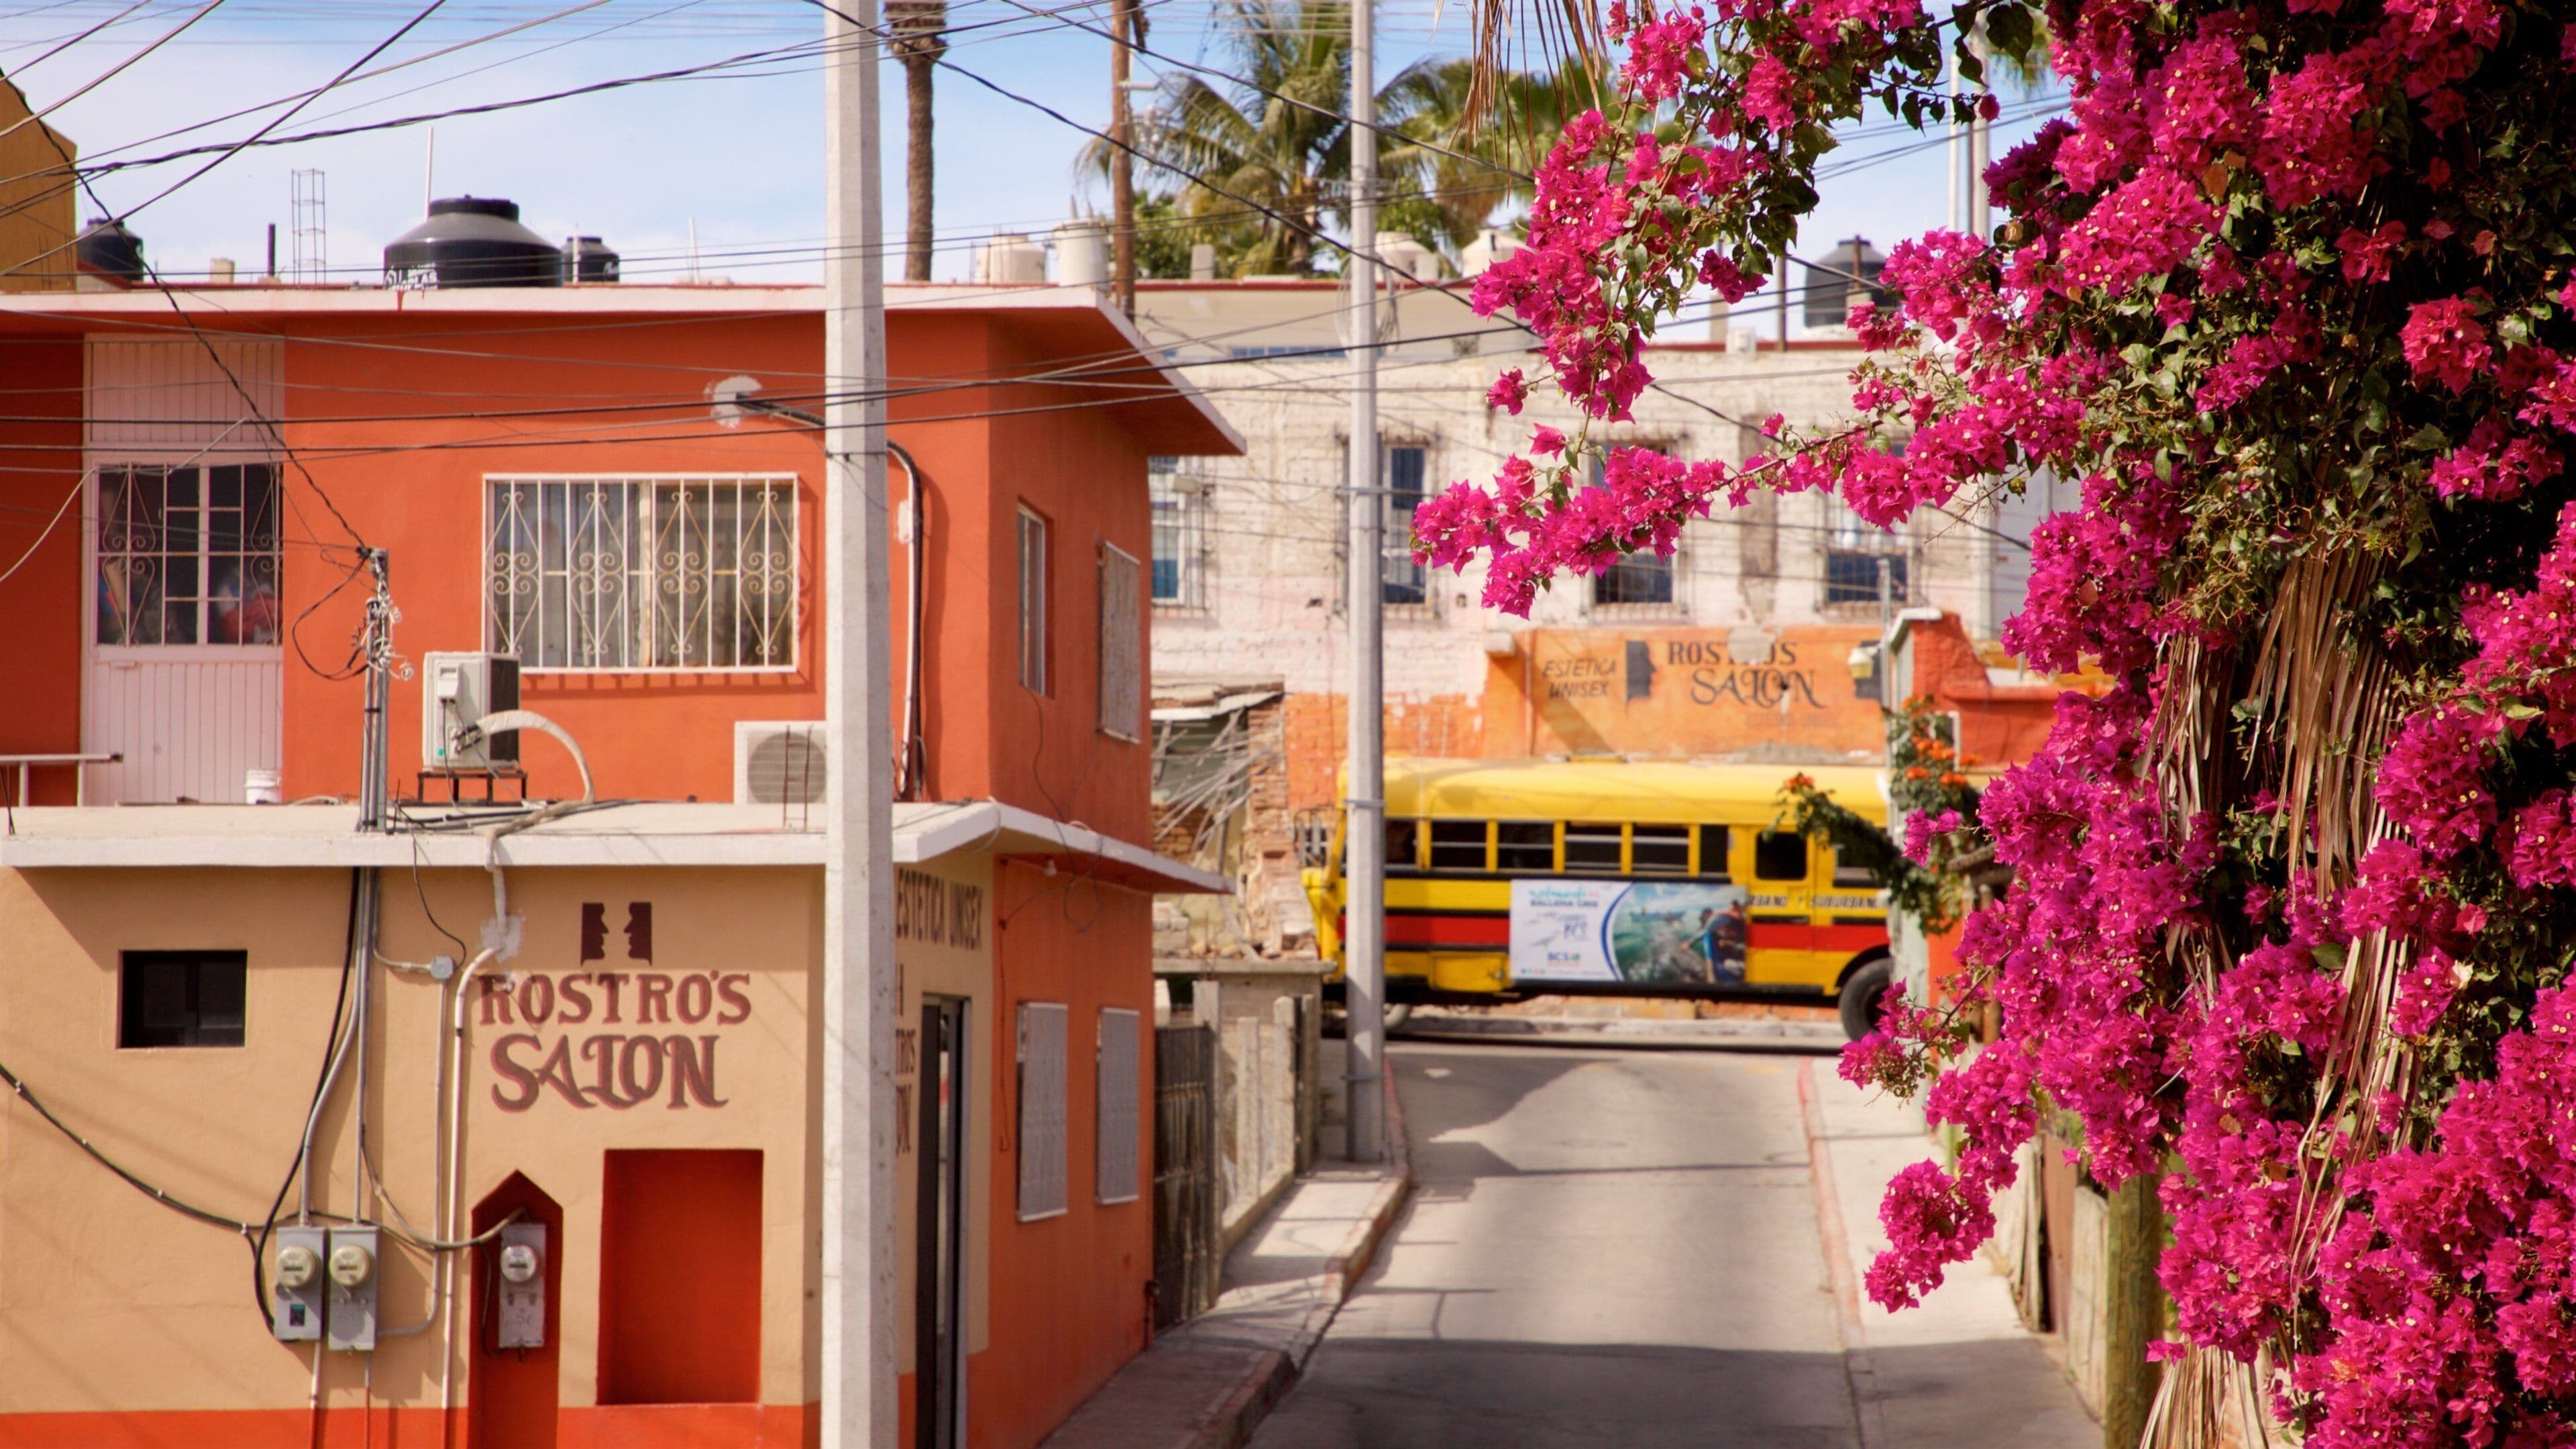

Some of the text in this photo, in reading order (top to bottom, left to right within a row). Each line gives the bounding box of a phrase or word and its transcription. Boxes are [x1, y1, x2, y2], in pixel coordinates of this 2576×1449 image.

[1542, 657, 1615, 677] ESTETICA
[1549, 680, 1609, 698] UNISEX
[1691, 668, 1827, 708] SALON
[478, 970, 751, 1026] ROSTRO'S
[490, 1033, 729, 1113] SALON
